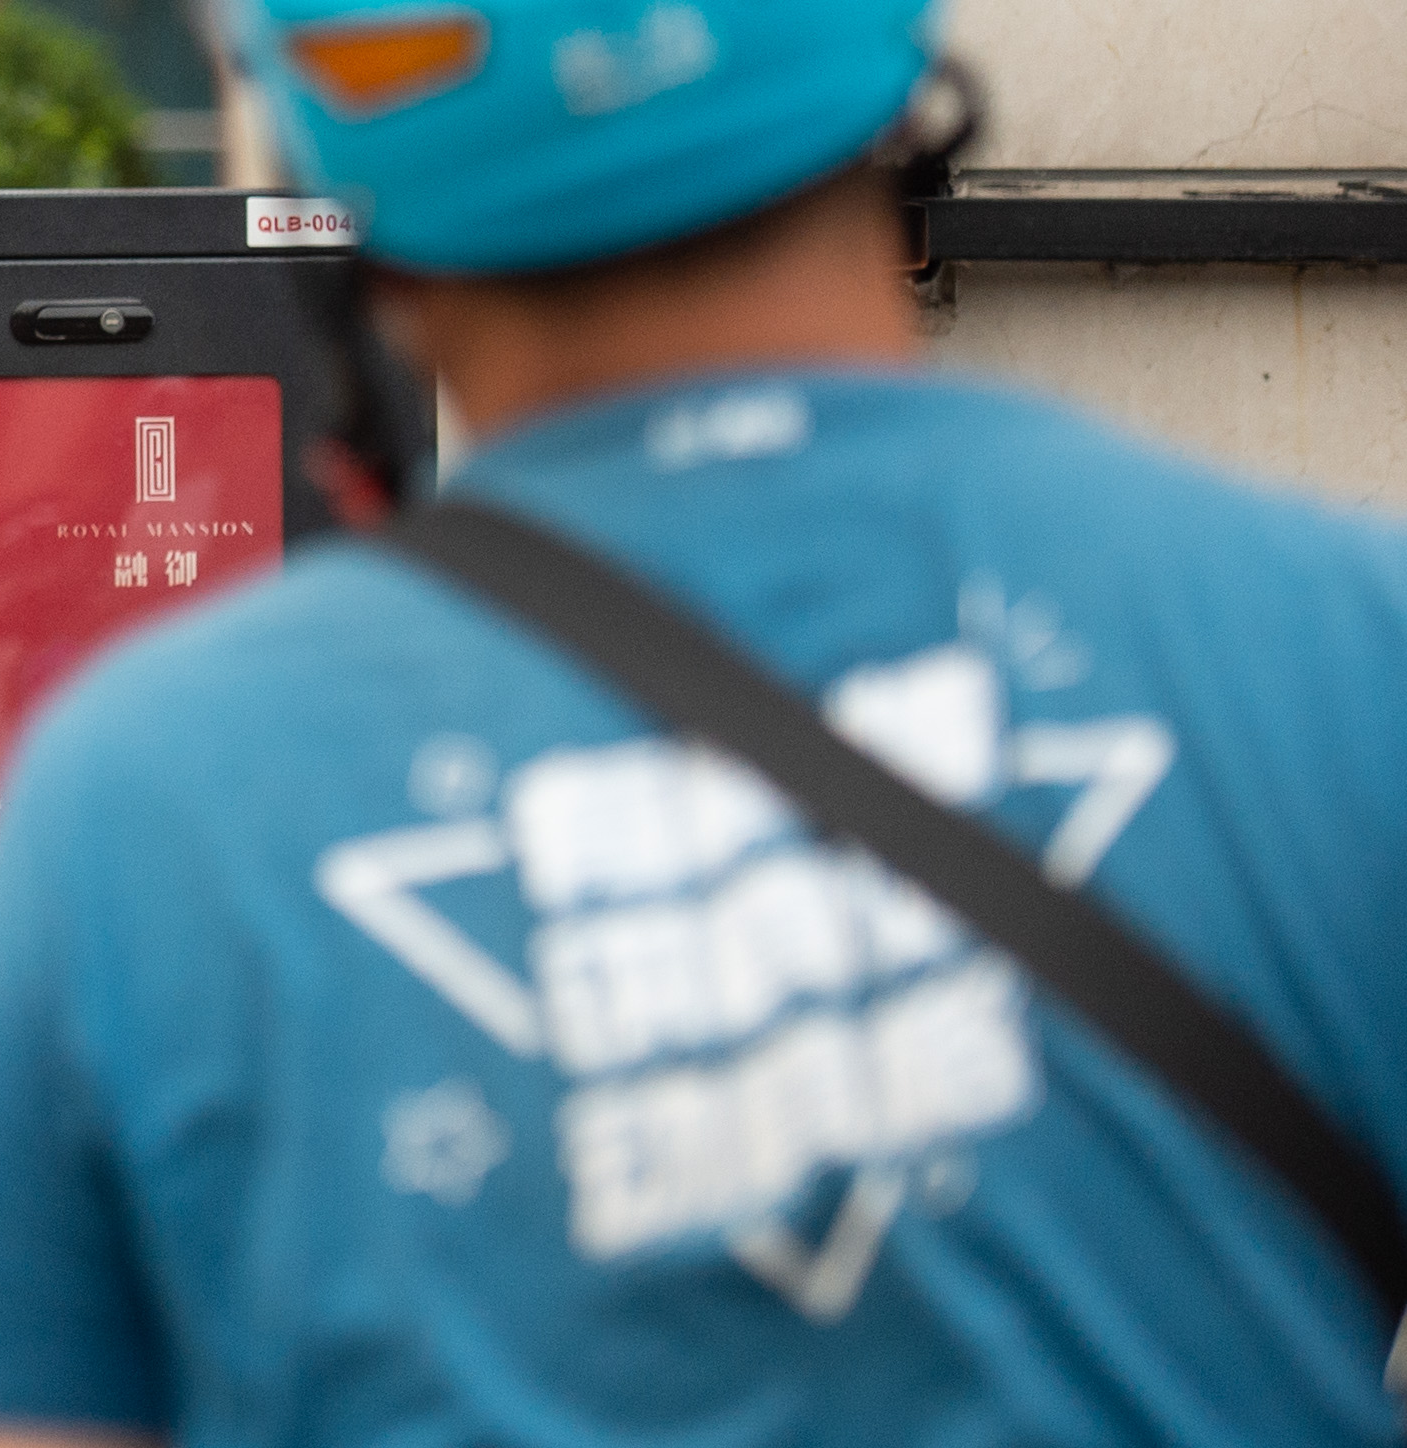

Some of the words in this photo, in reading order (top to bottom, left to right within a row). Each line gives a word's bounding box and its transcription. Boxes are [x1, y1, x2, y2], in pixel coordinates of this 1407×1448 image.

[258, 214, 363, 233] QLB-004
[146, 520, 254, 538] MANSION
[114, 549, 198, 588] 融御
